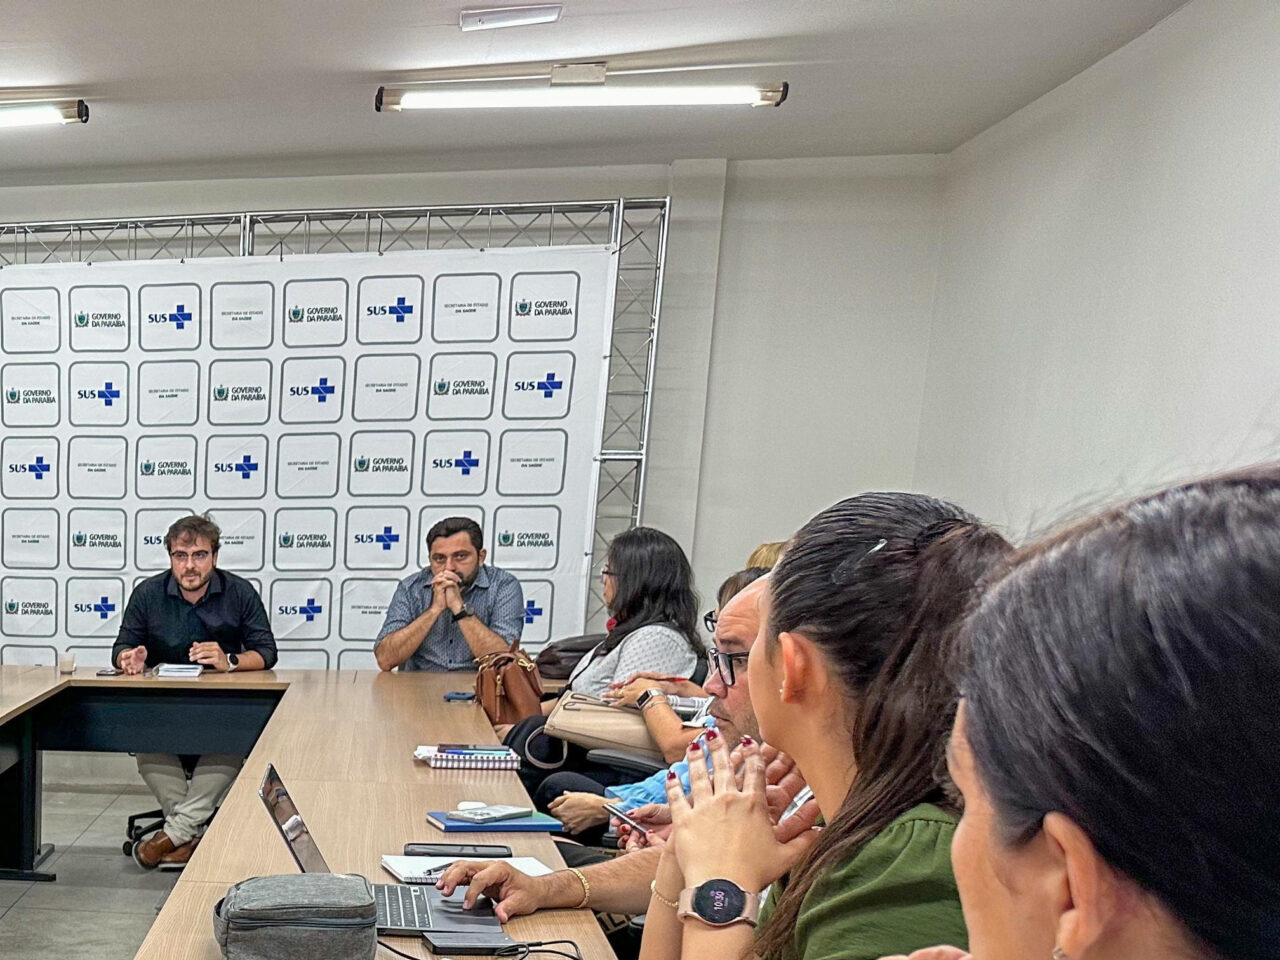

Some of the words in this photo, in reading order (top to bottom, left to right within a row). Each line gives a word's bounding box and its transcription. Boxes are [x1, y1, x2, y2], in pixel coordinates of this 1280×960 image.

[534, 300, 568, 309] GOVERNO
[307, 306, 338, 315] GOVERNO
[367, 305, 387, 316] SUS
[91, 313, 121, 321] GOVERNO
[148, 313, 167, 324] SUS
[306, 315, 316, 323] DA
[453, 380, 485, 388] GOVERNO
[514, 381, 535, 391] SUS
[22, 389, 52, 397] GOVERNO
[77, 390, 96, 399] SUS
[231, 386, 262, 394] GOVERNO
[290, 386, 309, 396] SUS
[452, 387, 462, 396] DA
[157, 461, 188, 469] GOVERNO
[372, 457, 404, 465] GOVERNO
[432, 458, 453, 468] SUS
[9, 464, 27, 473] SUS
[214, 463, 233, 472] SUS
[89, 533, 118, 541] GOVERNO
[144, 536, 162, 545] SUS
[354, 534, 374, 543] SUS
[517, 532, 550, 540] GOVERNO
[74, 603, 92, 613] SUS
[278, 606, 298, 615] SUS
